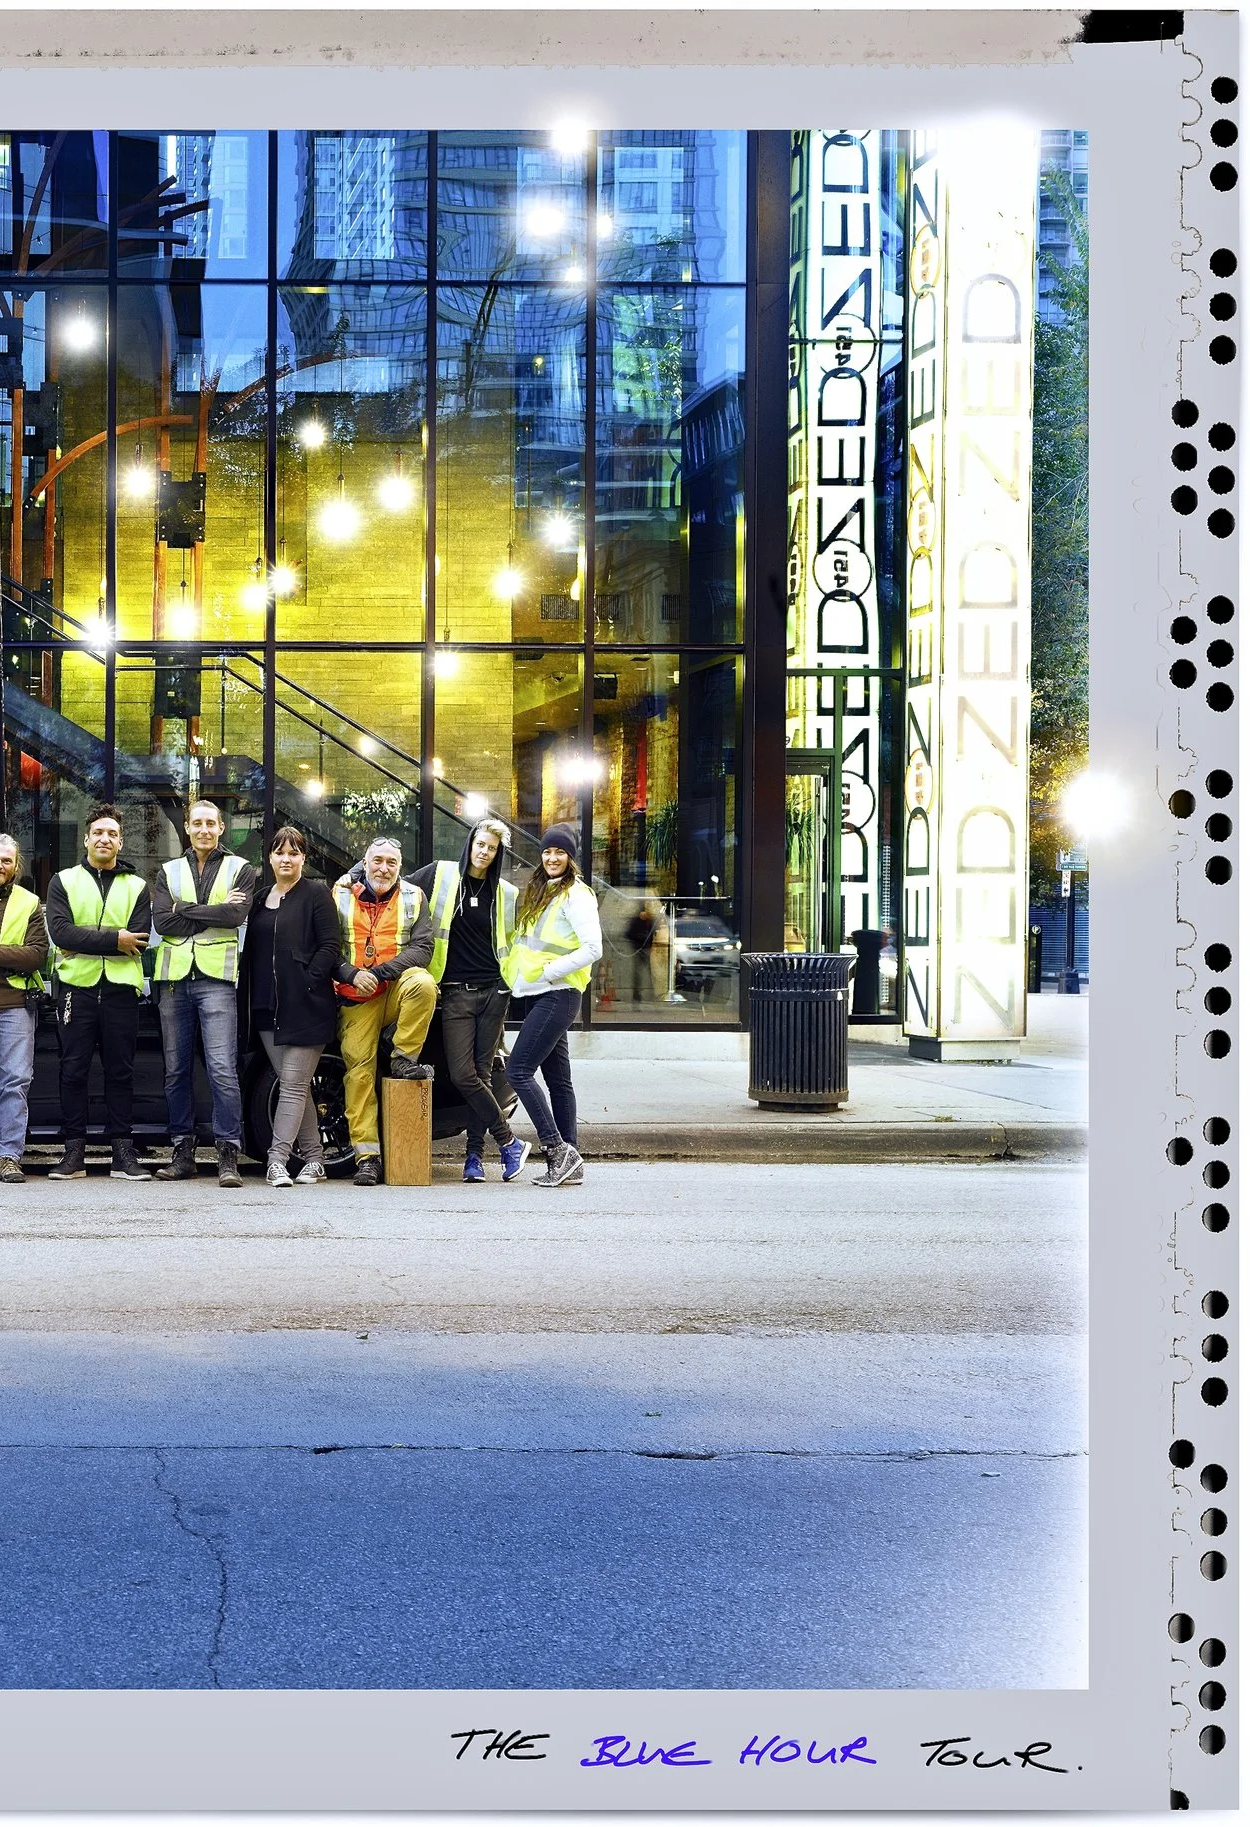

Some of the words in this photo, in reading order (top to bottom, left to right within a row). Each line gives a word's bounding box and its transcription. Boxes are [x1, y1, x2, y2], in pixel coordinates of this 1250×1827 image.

[909, 283, 936, 504] ZED
[907, 546, 934, 766] ZED
[956, 541, 1018, 767] ZED
[905, 806, 931, 1028] ZED
